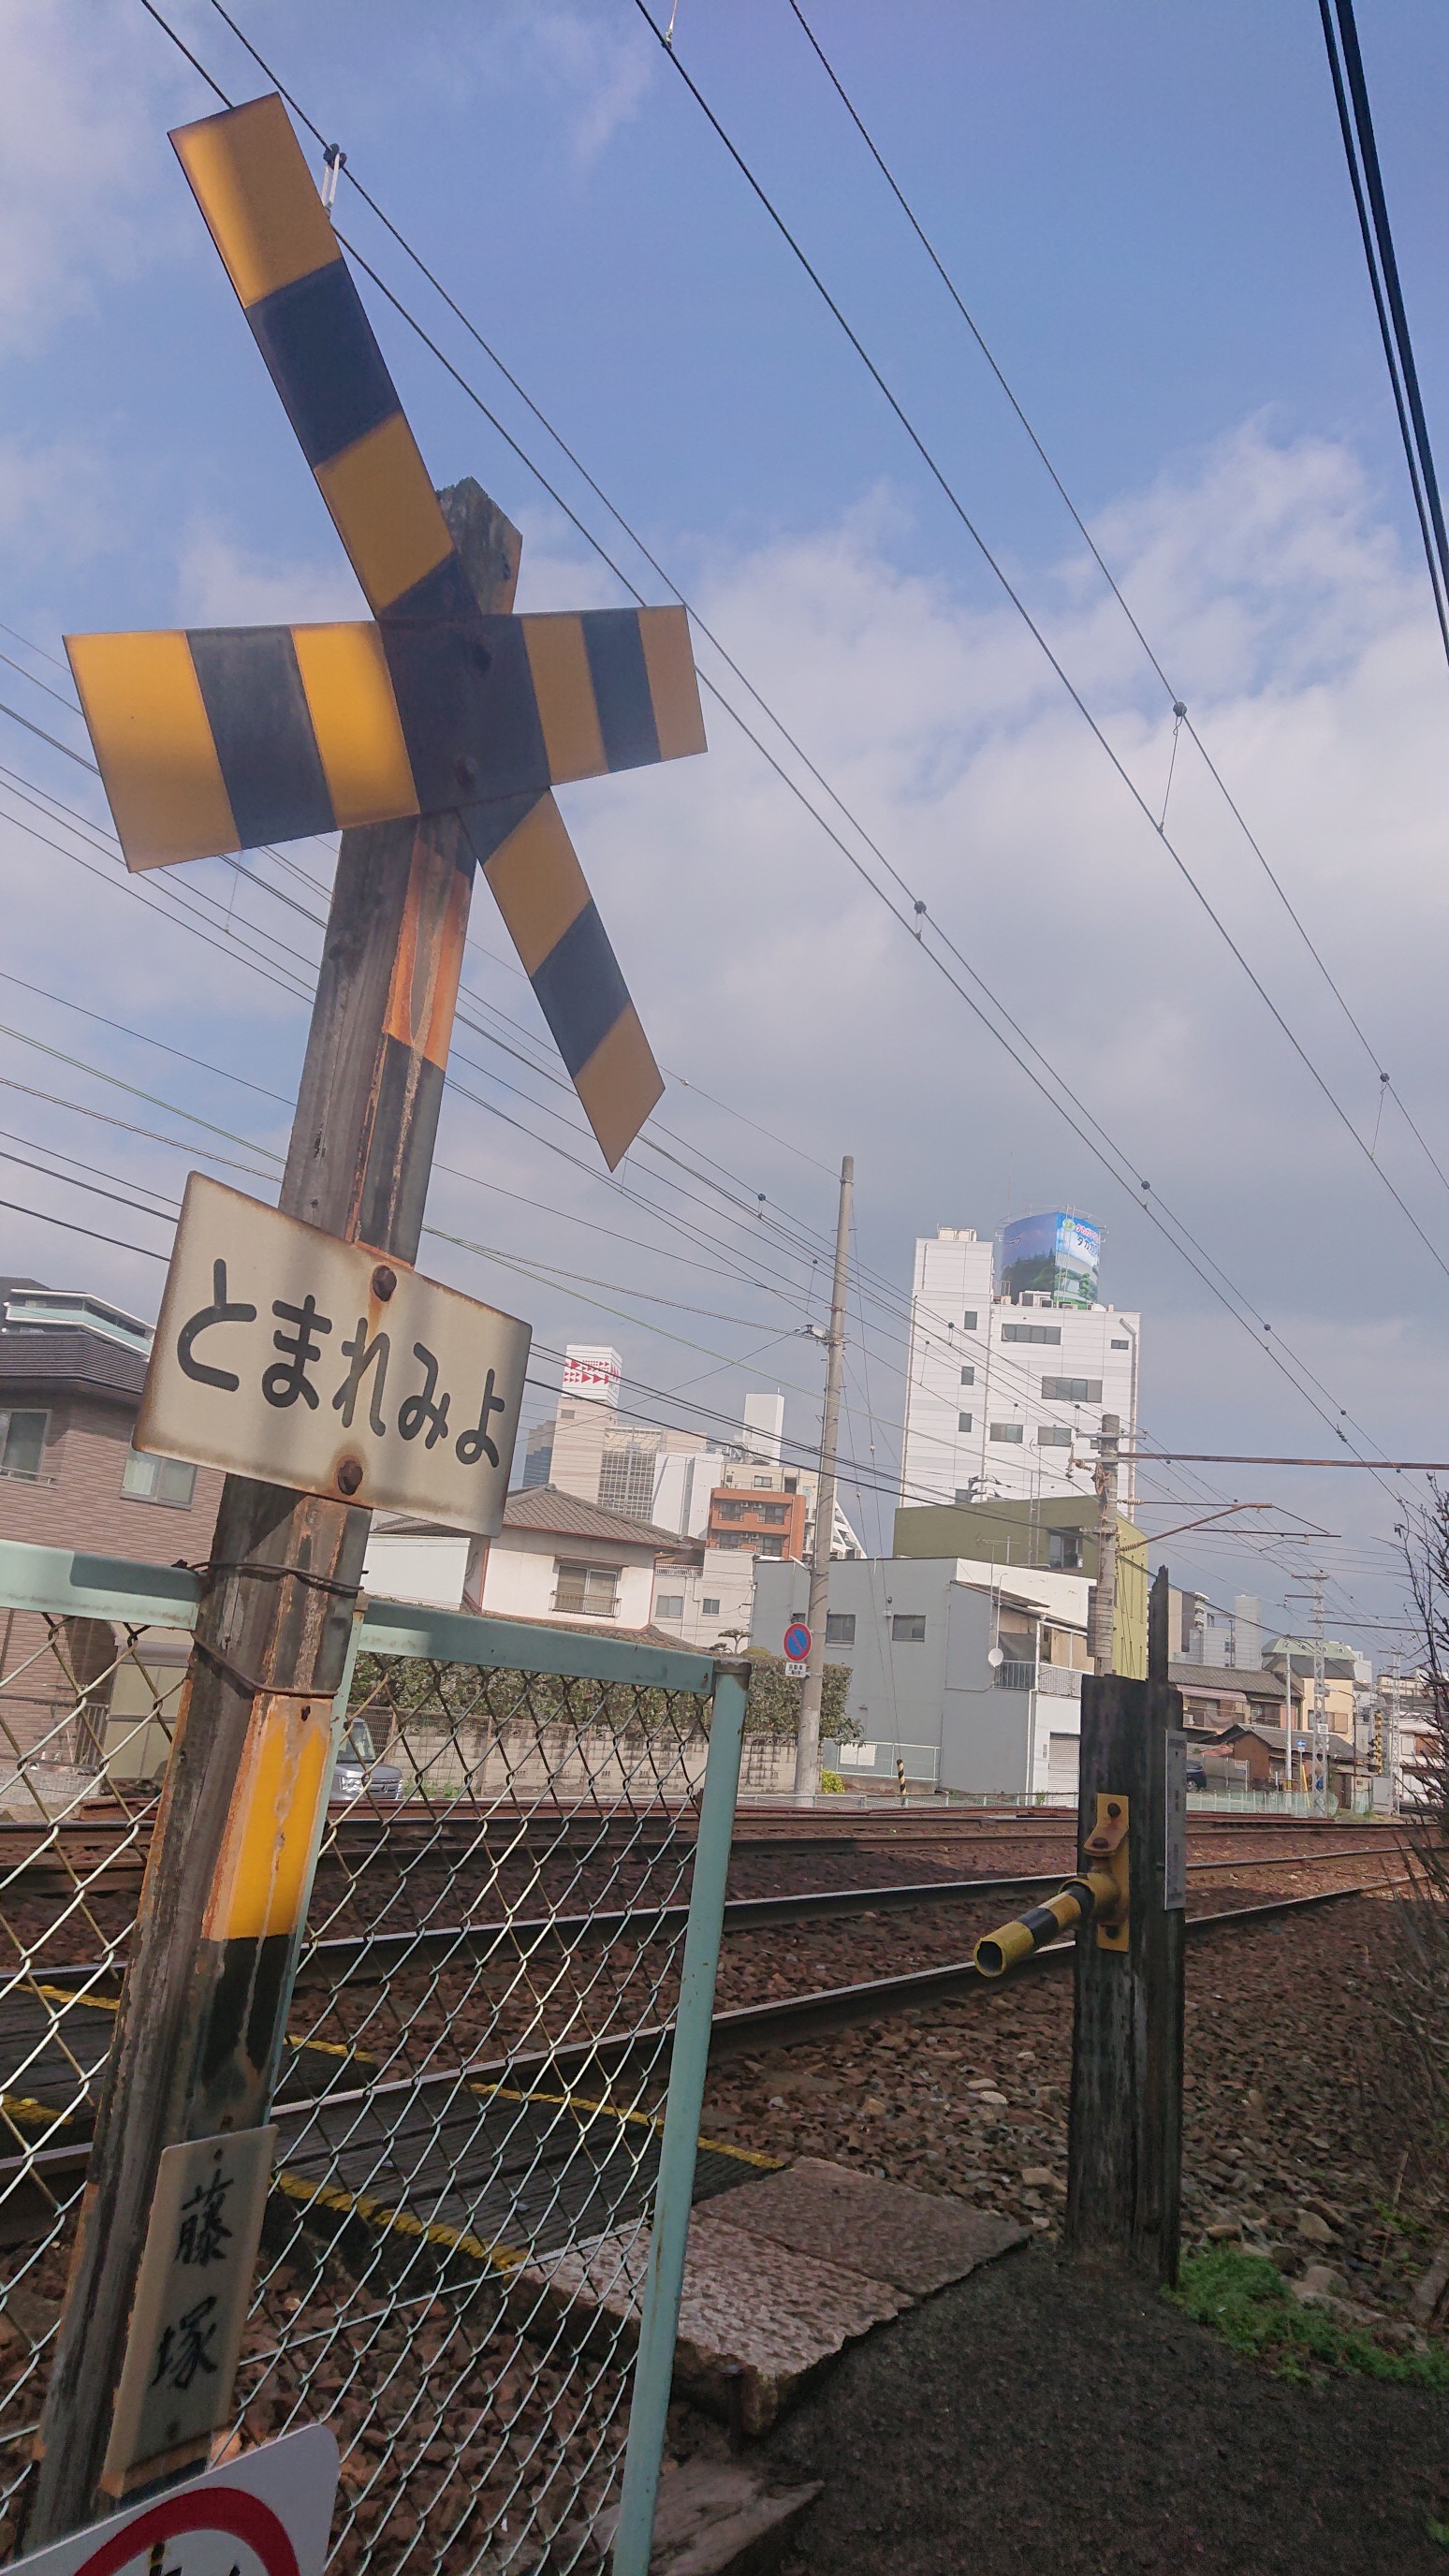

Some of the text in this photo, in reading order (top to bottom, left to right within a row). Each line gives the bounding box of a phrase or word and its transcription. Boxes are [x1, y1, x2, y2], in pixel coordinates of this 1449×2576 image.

[177, 1258, 505, 1468] とまれみよ
[153, 2169, 234, 2389] 藤塚
